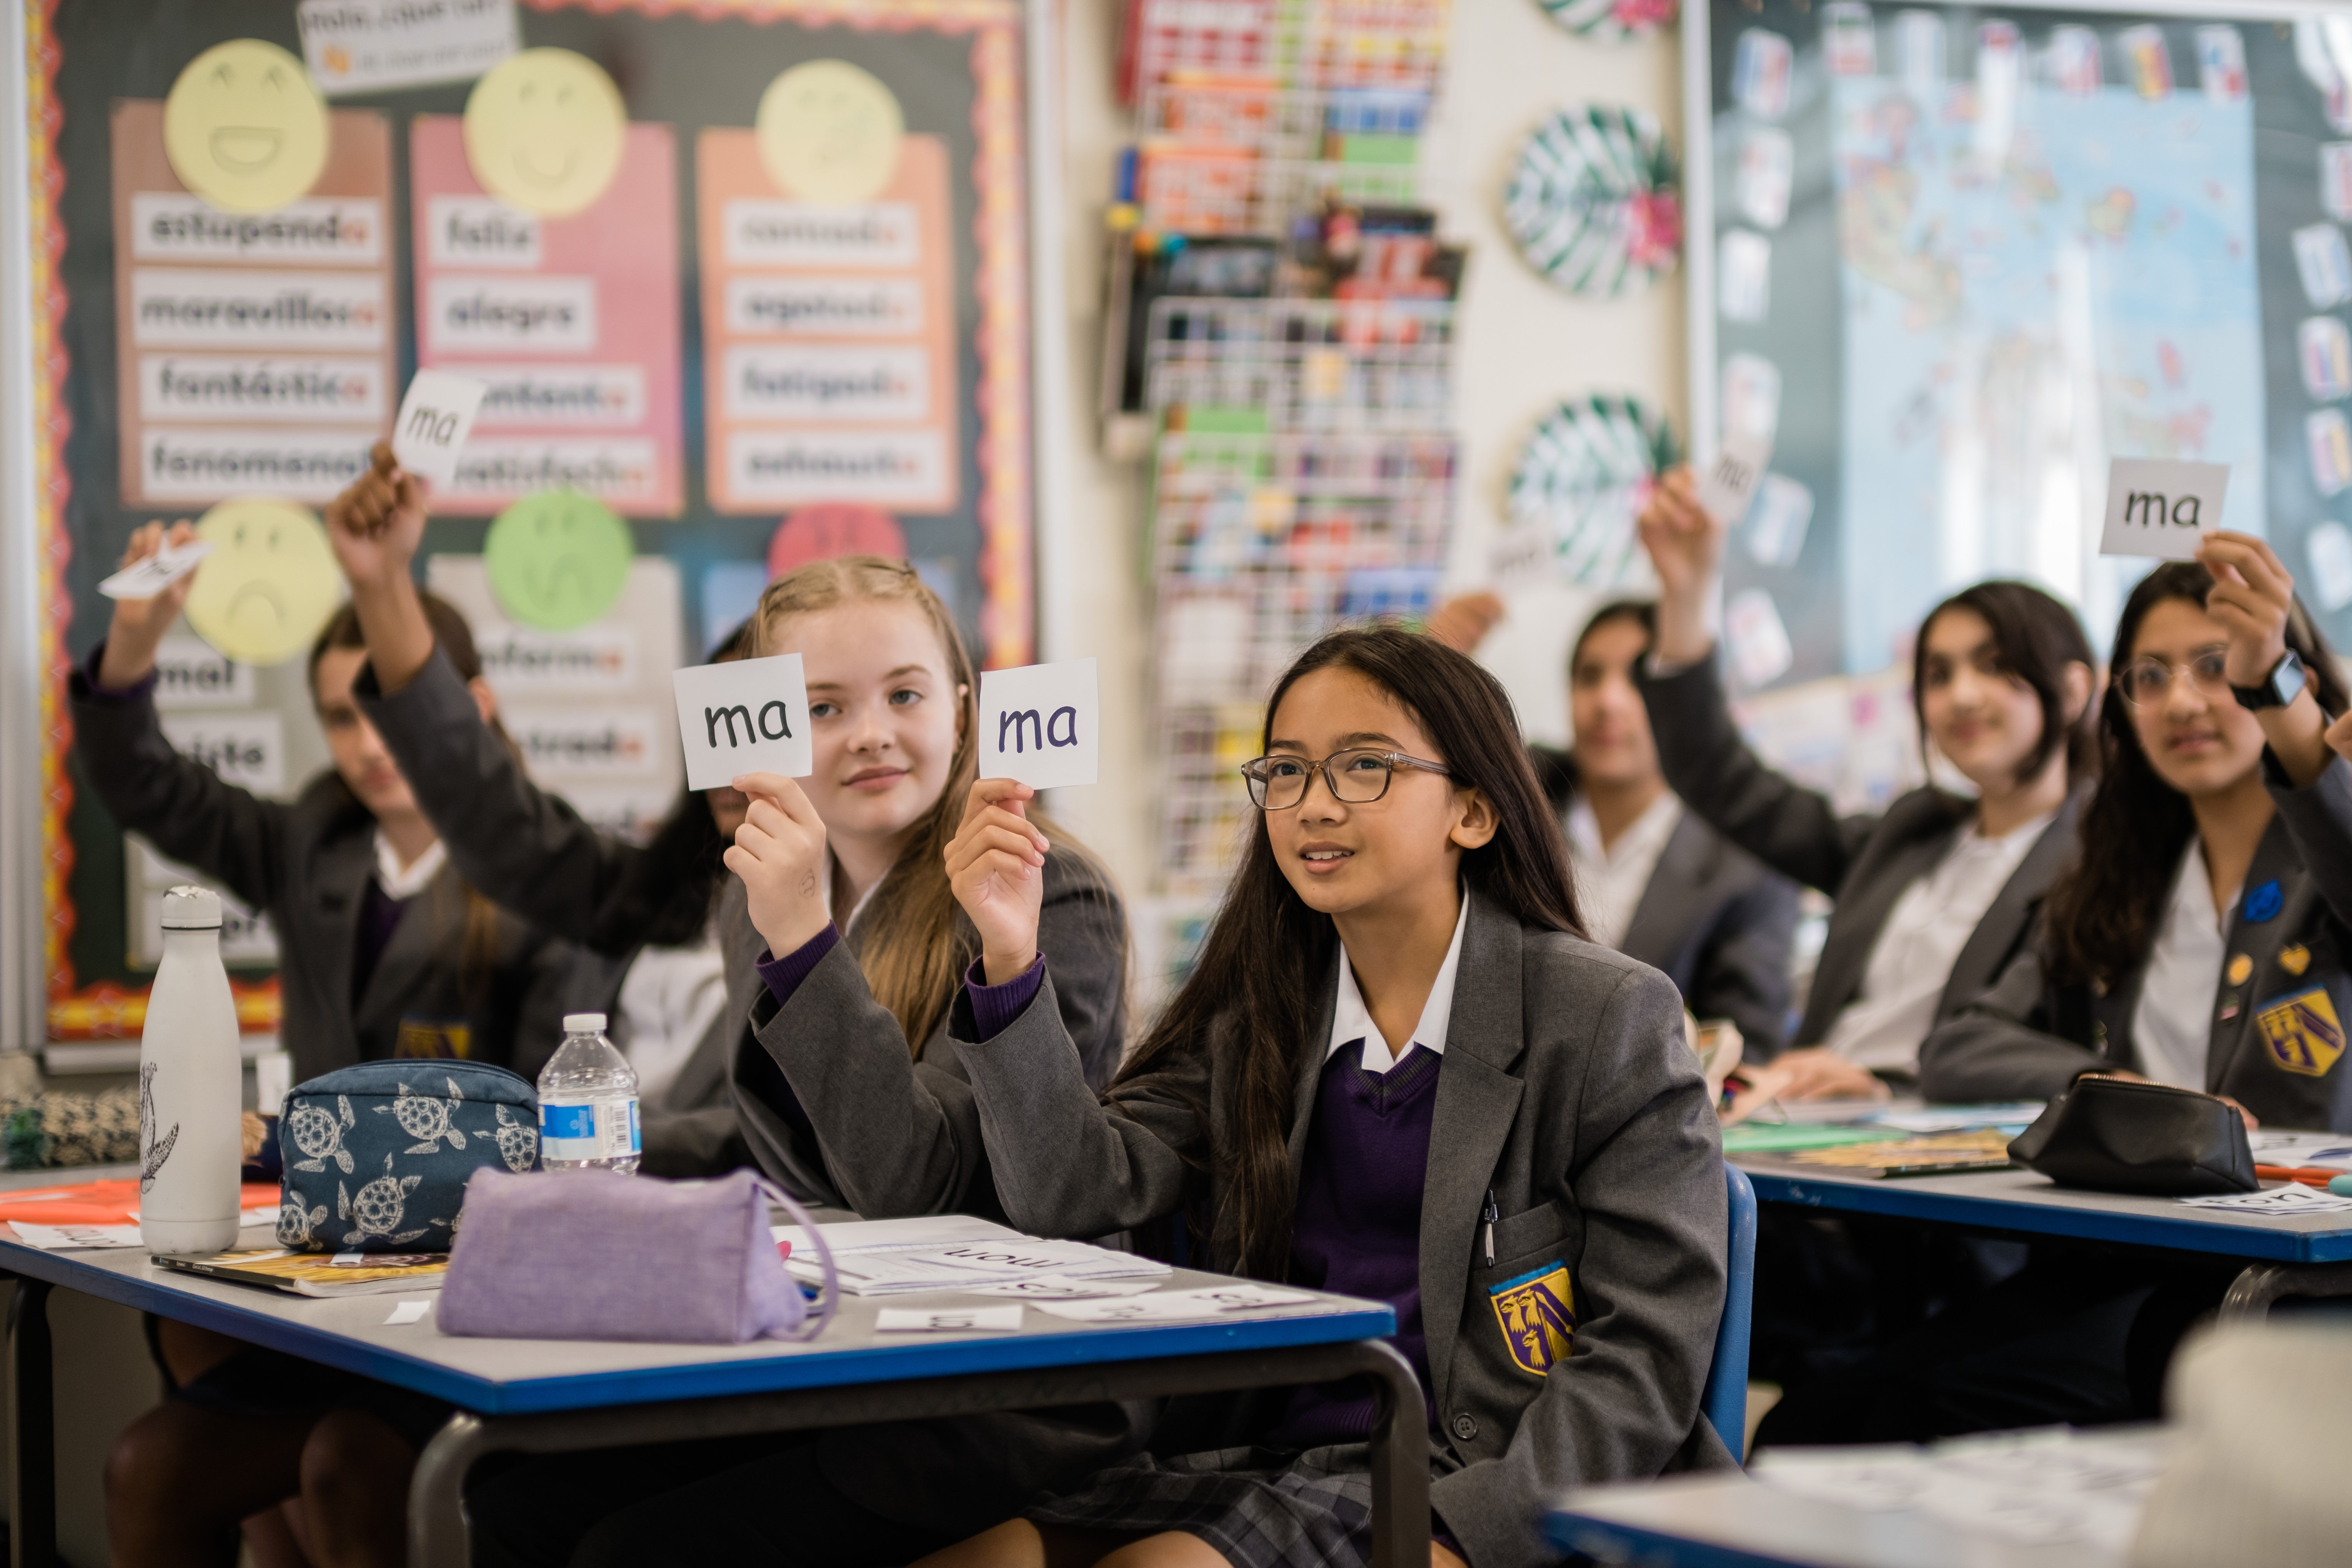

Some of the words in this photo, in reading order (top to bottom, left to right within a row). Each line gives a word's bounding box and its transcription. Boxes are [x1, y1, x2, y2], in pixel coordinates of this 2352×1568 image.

[405, 405, 459, 448] ma
[2125, 490, 2202, 528] ma
[705, 700, 792, 748] ma
[998, 706, 1078, 753] ma
[943, 1249, 1065, 1268] mon
